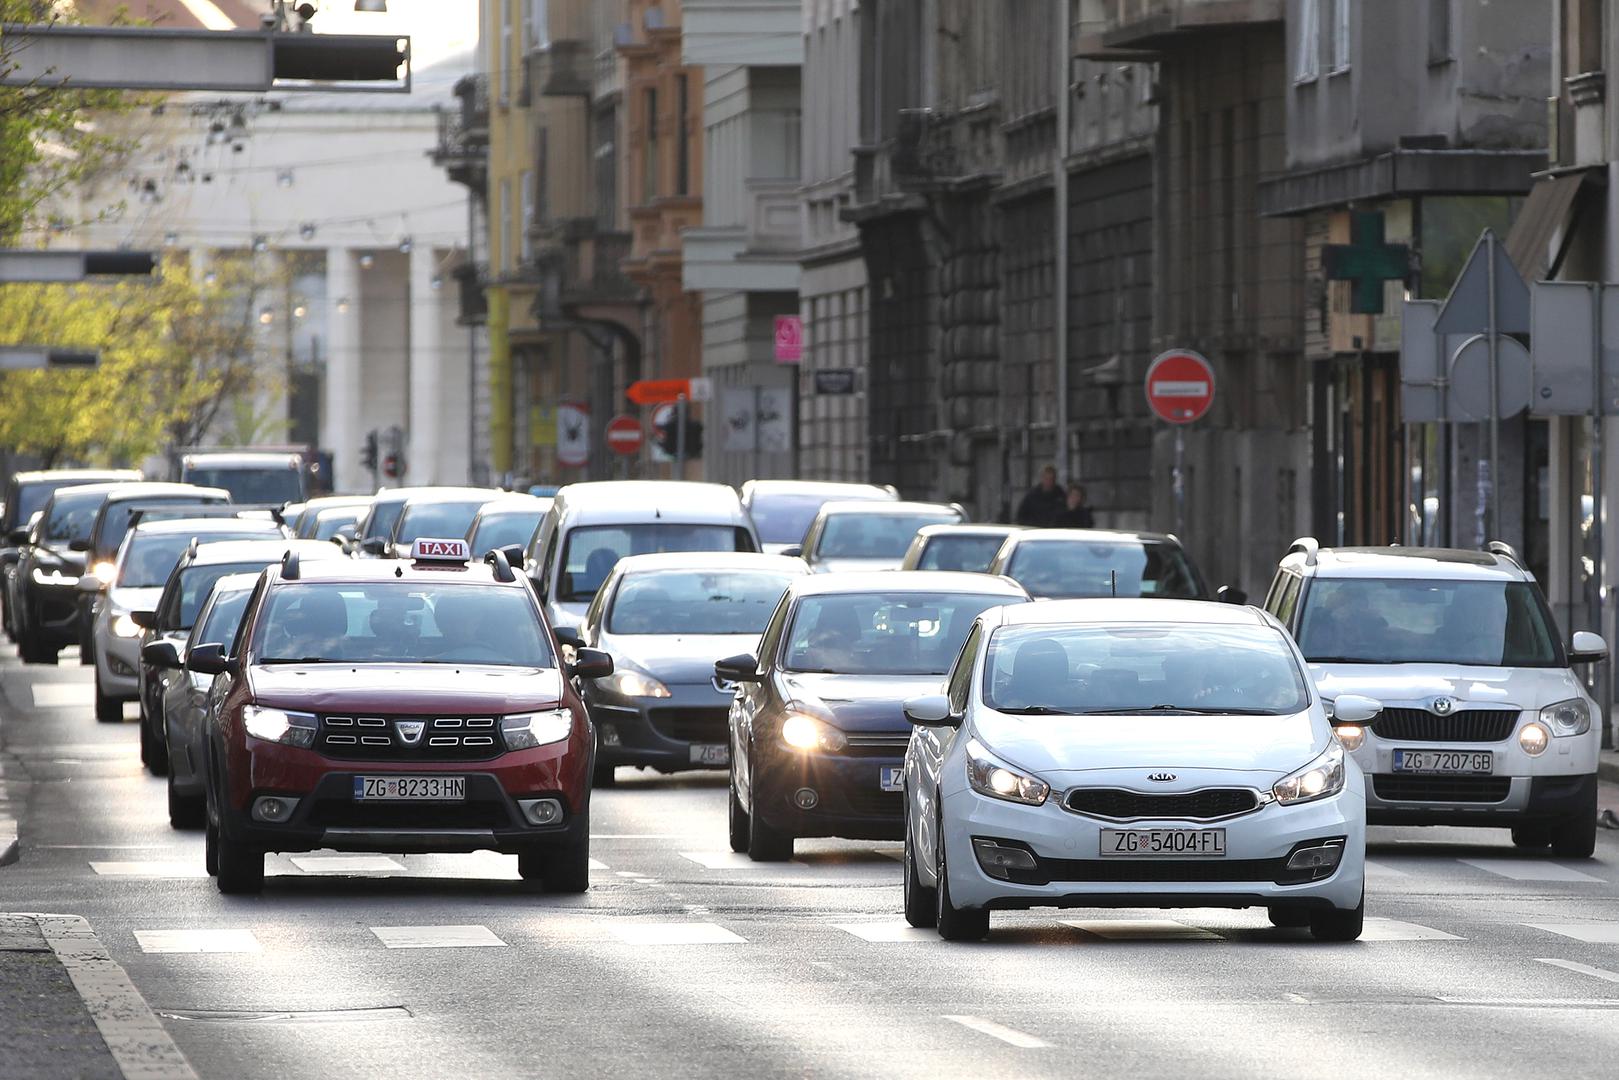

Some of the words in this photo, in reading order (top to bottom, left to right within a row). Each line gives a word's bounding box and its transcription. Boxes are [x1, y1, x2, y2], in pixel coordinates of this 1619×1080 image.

[421, 542, 461, 555] TAXI
[1404, 753, 1423, 769] ZG
[365, 779, 387, 797] ZG
[398, 779, 465, 797] 8233-HN
[1115, 832, 1138, 851] ZG
[1151, 832, 1223, 851] 5404-FL
